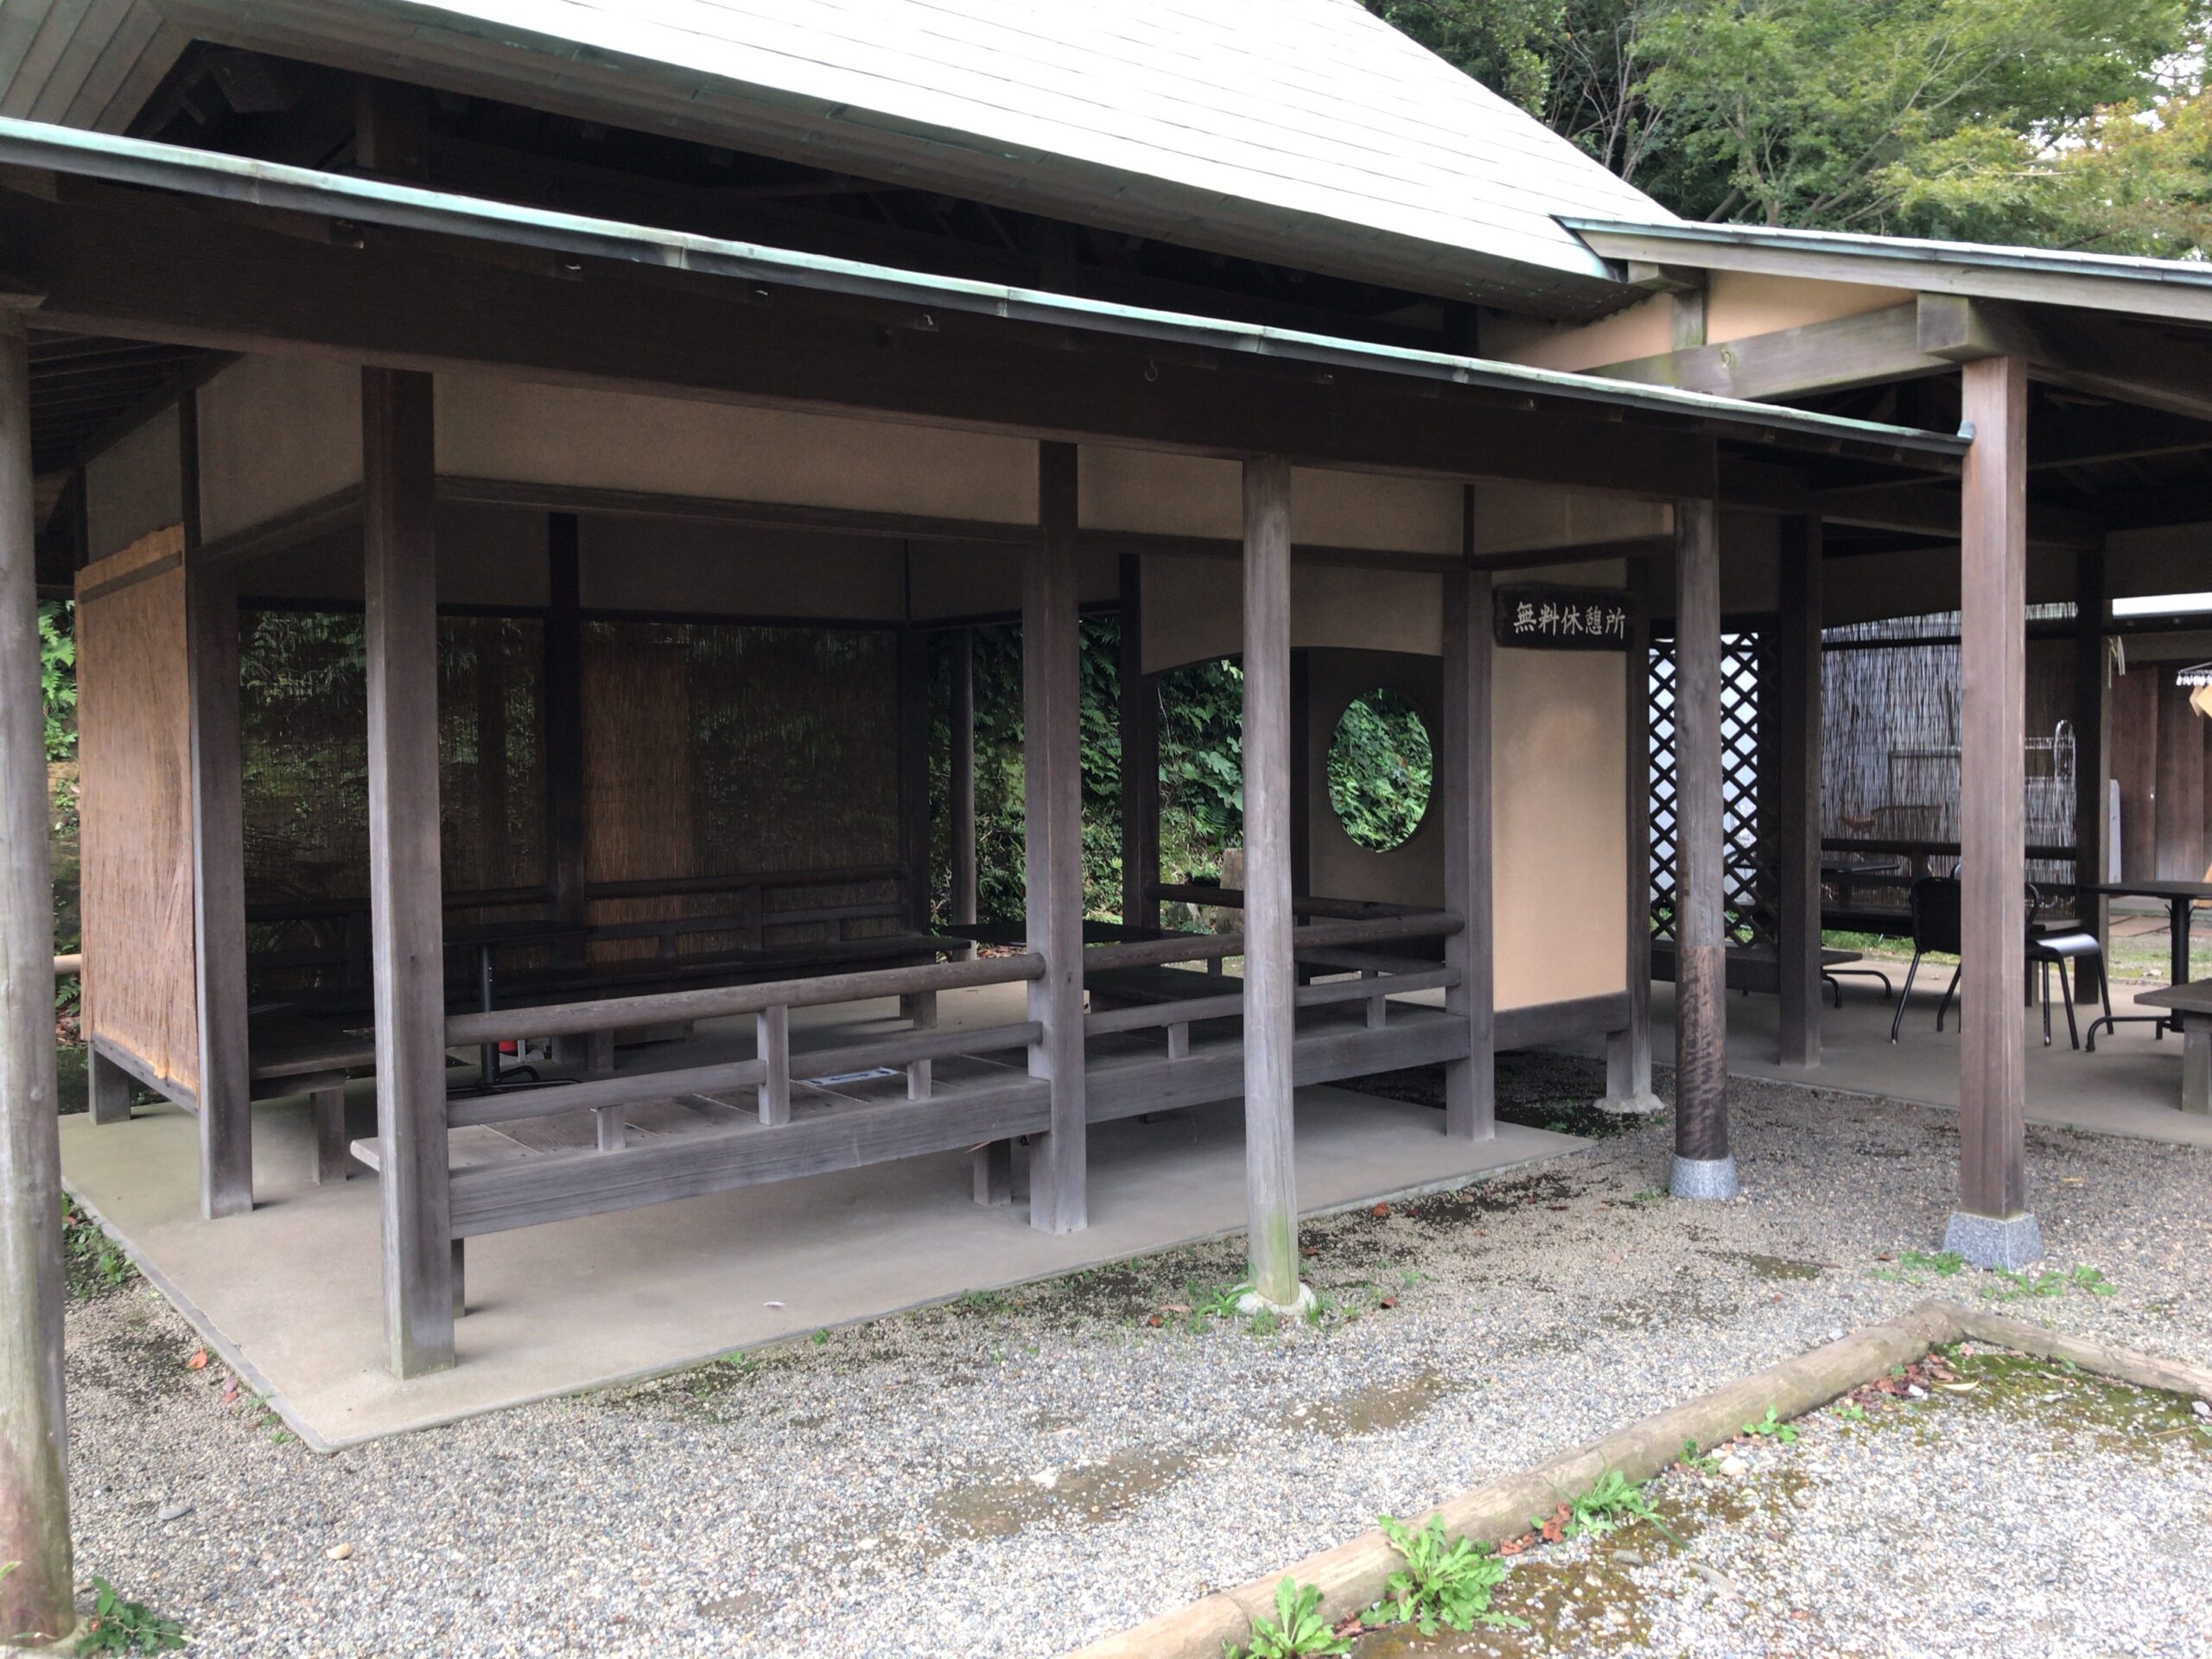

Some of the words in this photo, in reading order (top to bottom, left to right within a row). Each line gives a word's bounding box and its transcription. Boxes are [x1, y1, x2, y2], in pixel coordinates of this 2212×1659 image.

[1513, 601, 1625, 639] 無料休憩所
